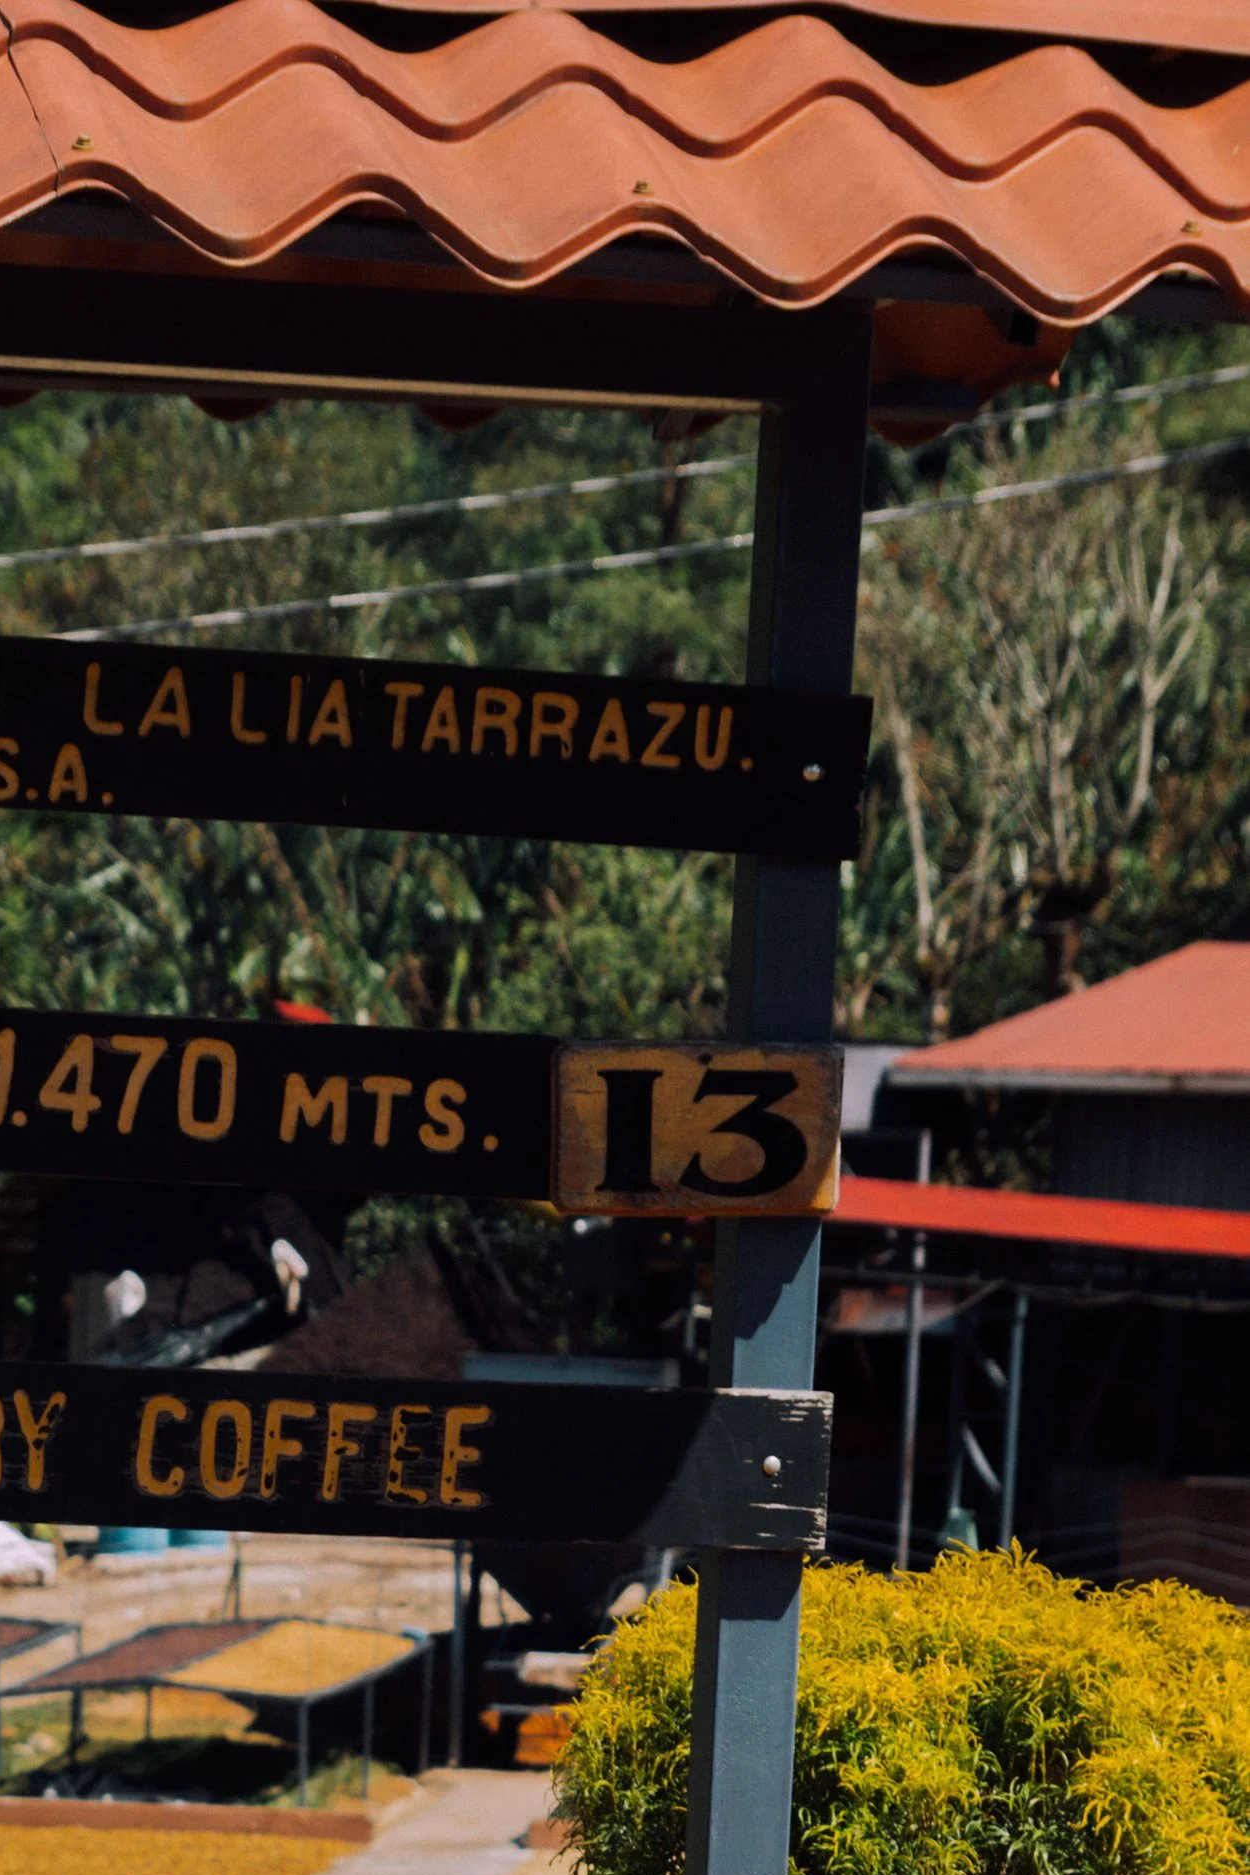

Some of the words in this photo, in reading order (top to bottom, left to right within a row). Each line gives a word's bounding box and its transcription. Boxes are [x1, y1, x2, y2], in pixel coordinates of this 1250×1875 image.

[82, 661, 193, 739] LA
[229, 670, 353, 748] LIA
[384, 680, 754, 772] TARRAZU.
[278, 1070, 501, 1154] MTS.
[594, 1067, 808, 1198] 13
[134, 1393, 494, 1510] COFFEE
